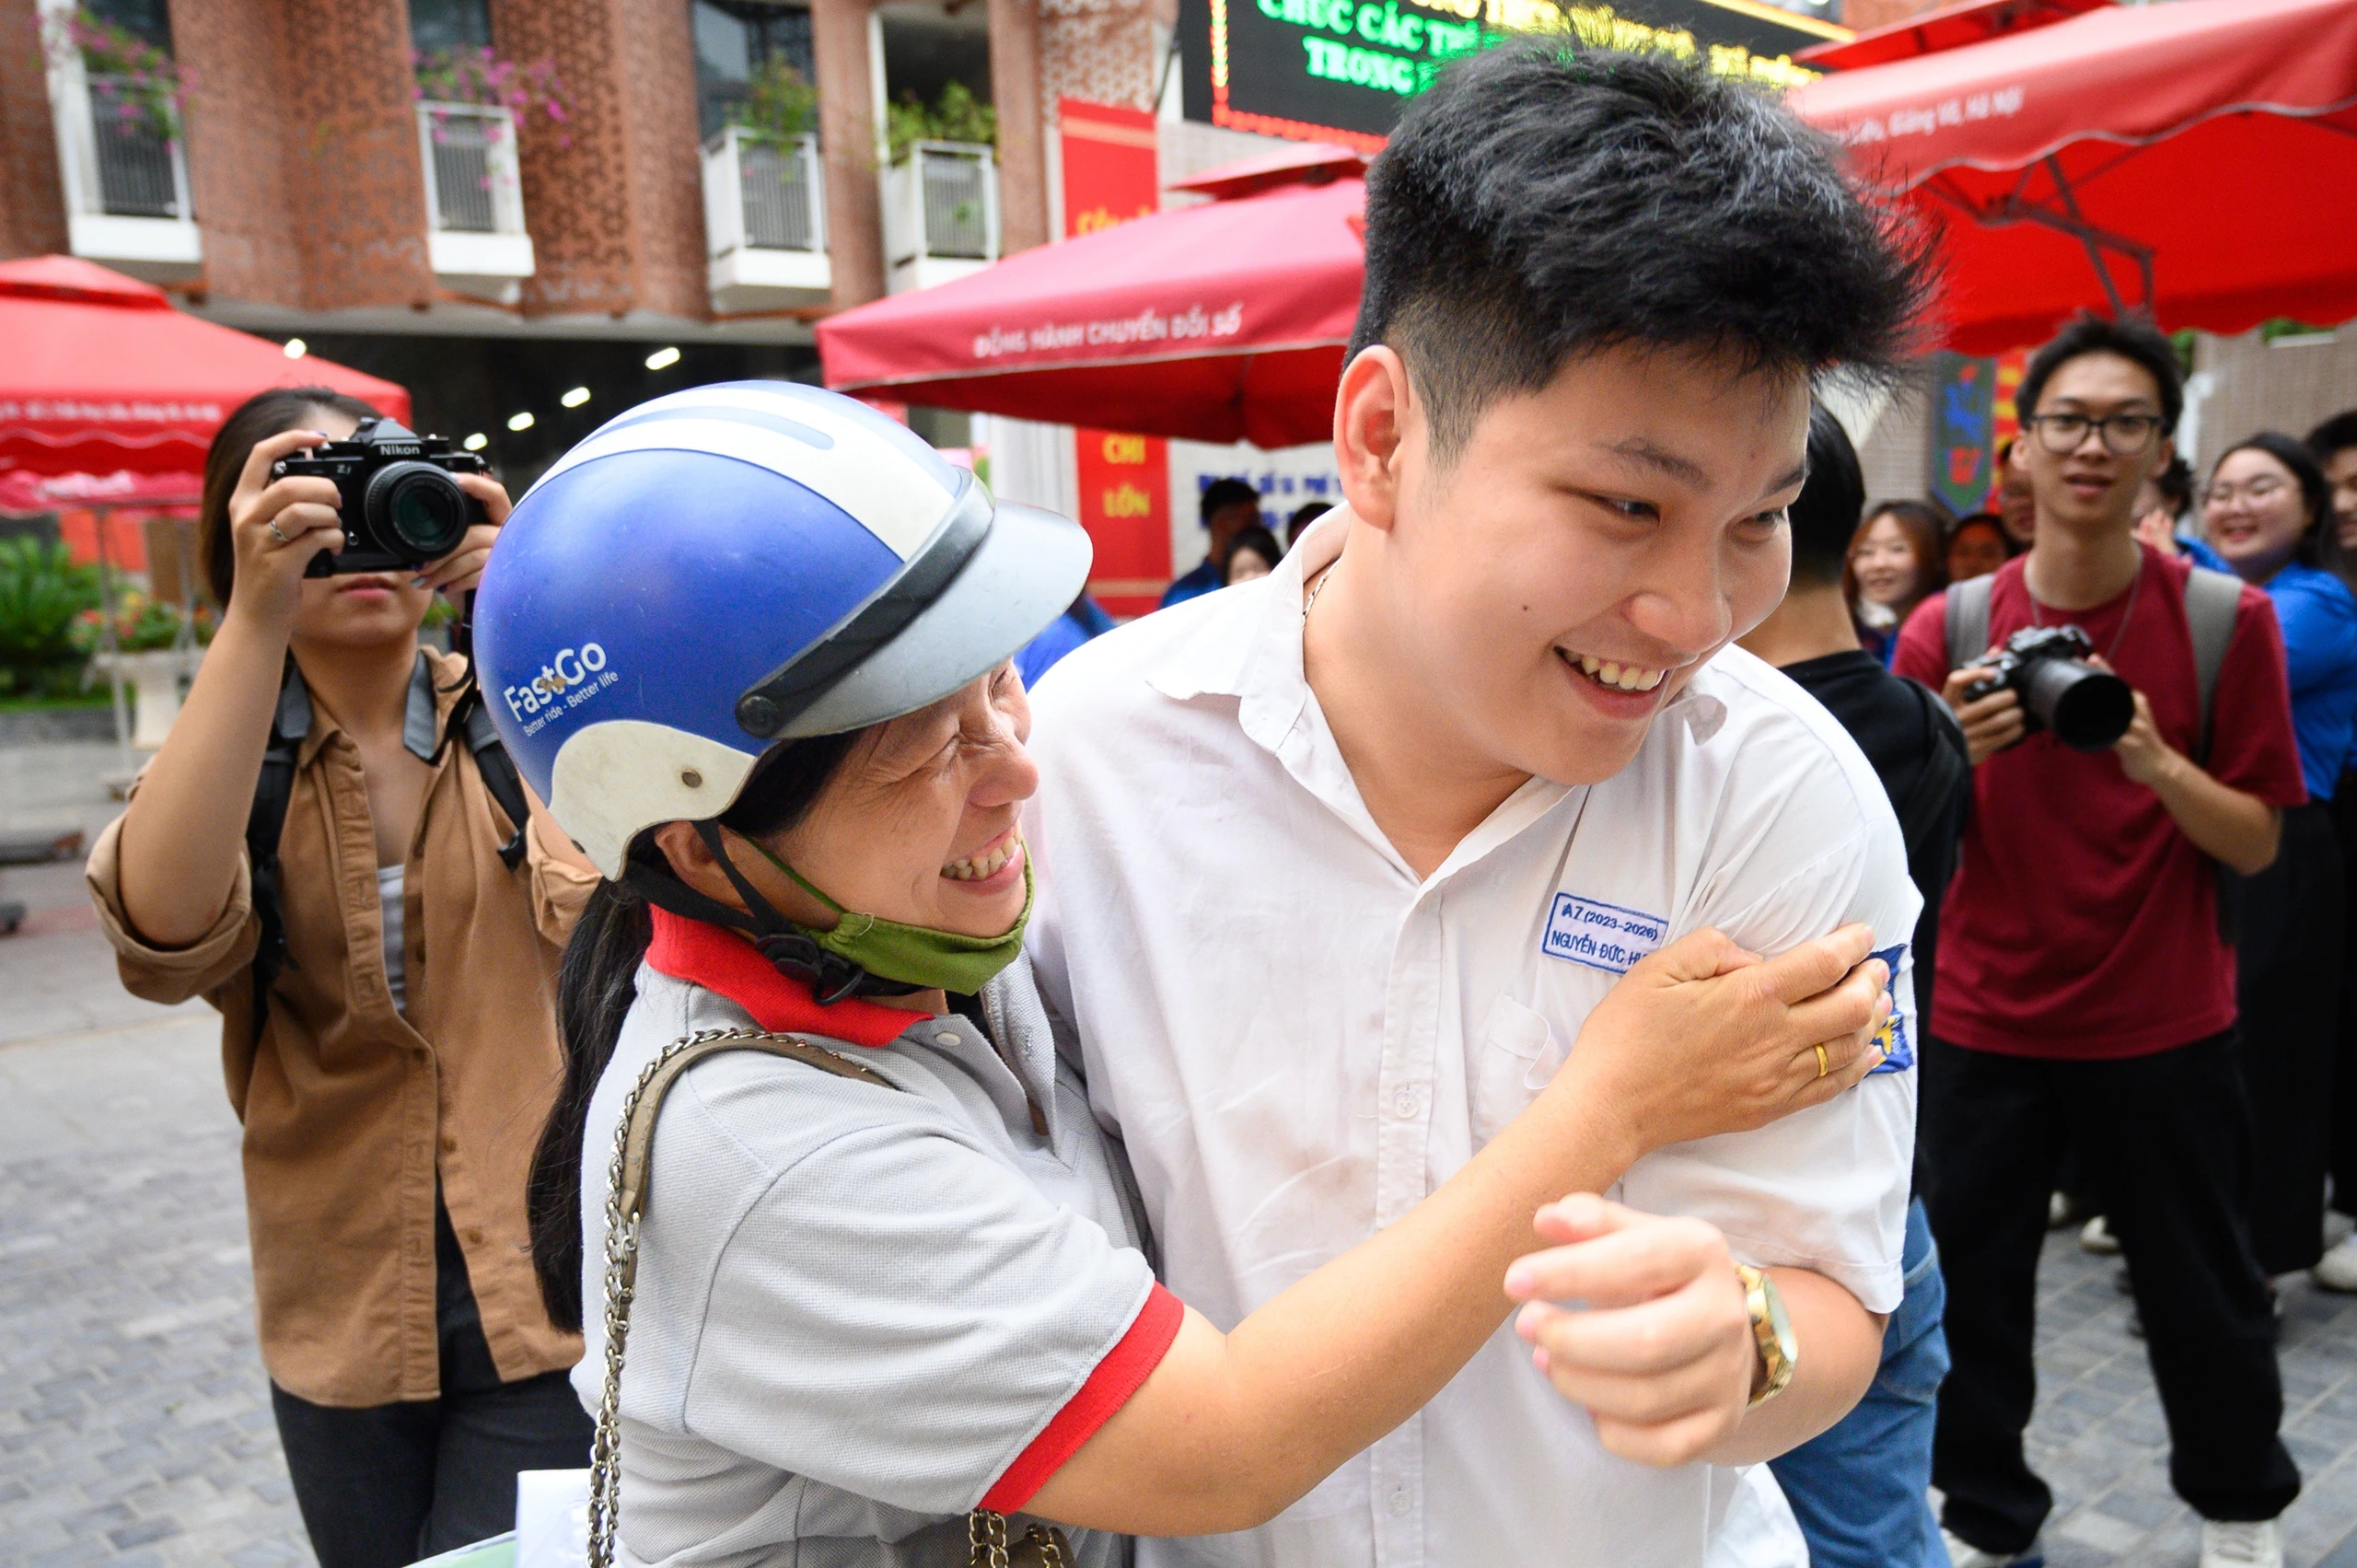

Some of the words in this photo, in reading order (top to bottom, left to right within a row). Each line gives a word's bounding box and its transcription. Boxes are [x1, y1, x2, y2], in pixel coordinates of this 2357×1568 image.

[1303, 36, 1415, 94] TRONG
[973, 326, 1028, 358] ĐỒNG
[1029, 322, 1084, 349] HÀNH
[1086, 308, 1167, 345] CHUYỂN
[1171, 303, 1209, 340] ĐỔI
[1212, 301, 1242, 336] SỐ
[380, 445, 420, 456] Nikon
[1102, 482, 1150, 517] LỚN
[503, 642, 607, 722] FastGo
[523, 716, 546, 737] Better
[544, 705, 563, 723] ride
[566, 682, 600, 707] Better
[598, 671, 619, 688] life
[1550, 930, 1596, 956] NGUYỄN
[1599, 944, 1625, 963] ĐỨC
